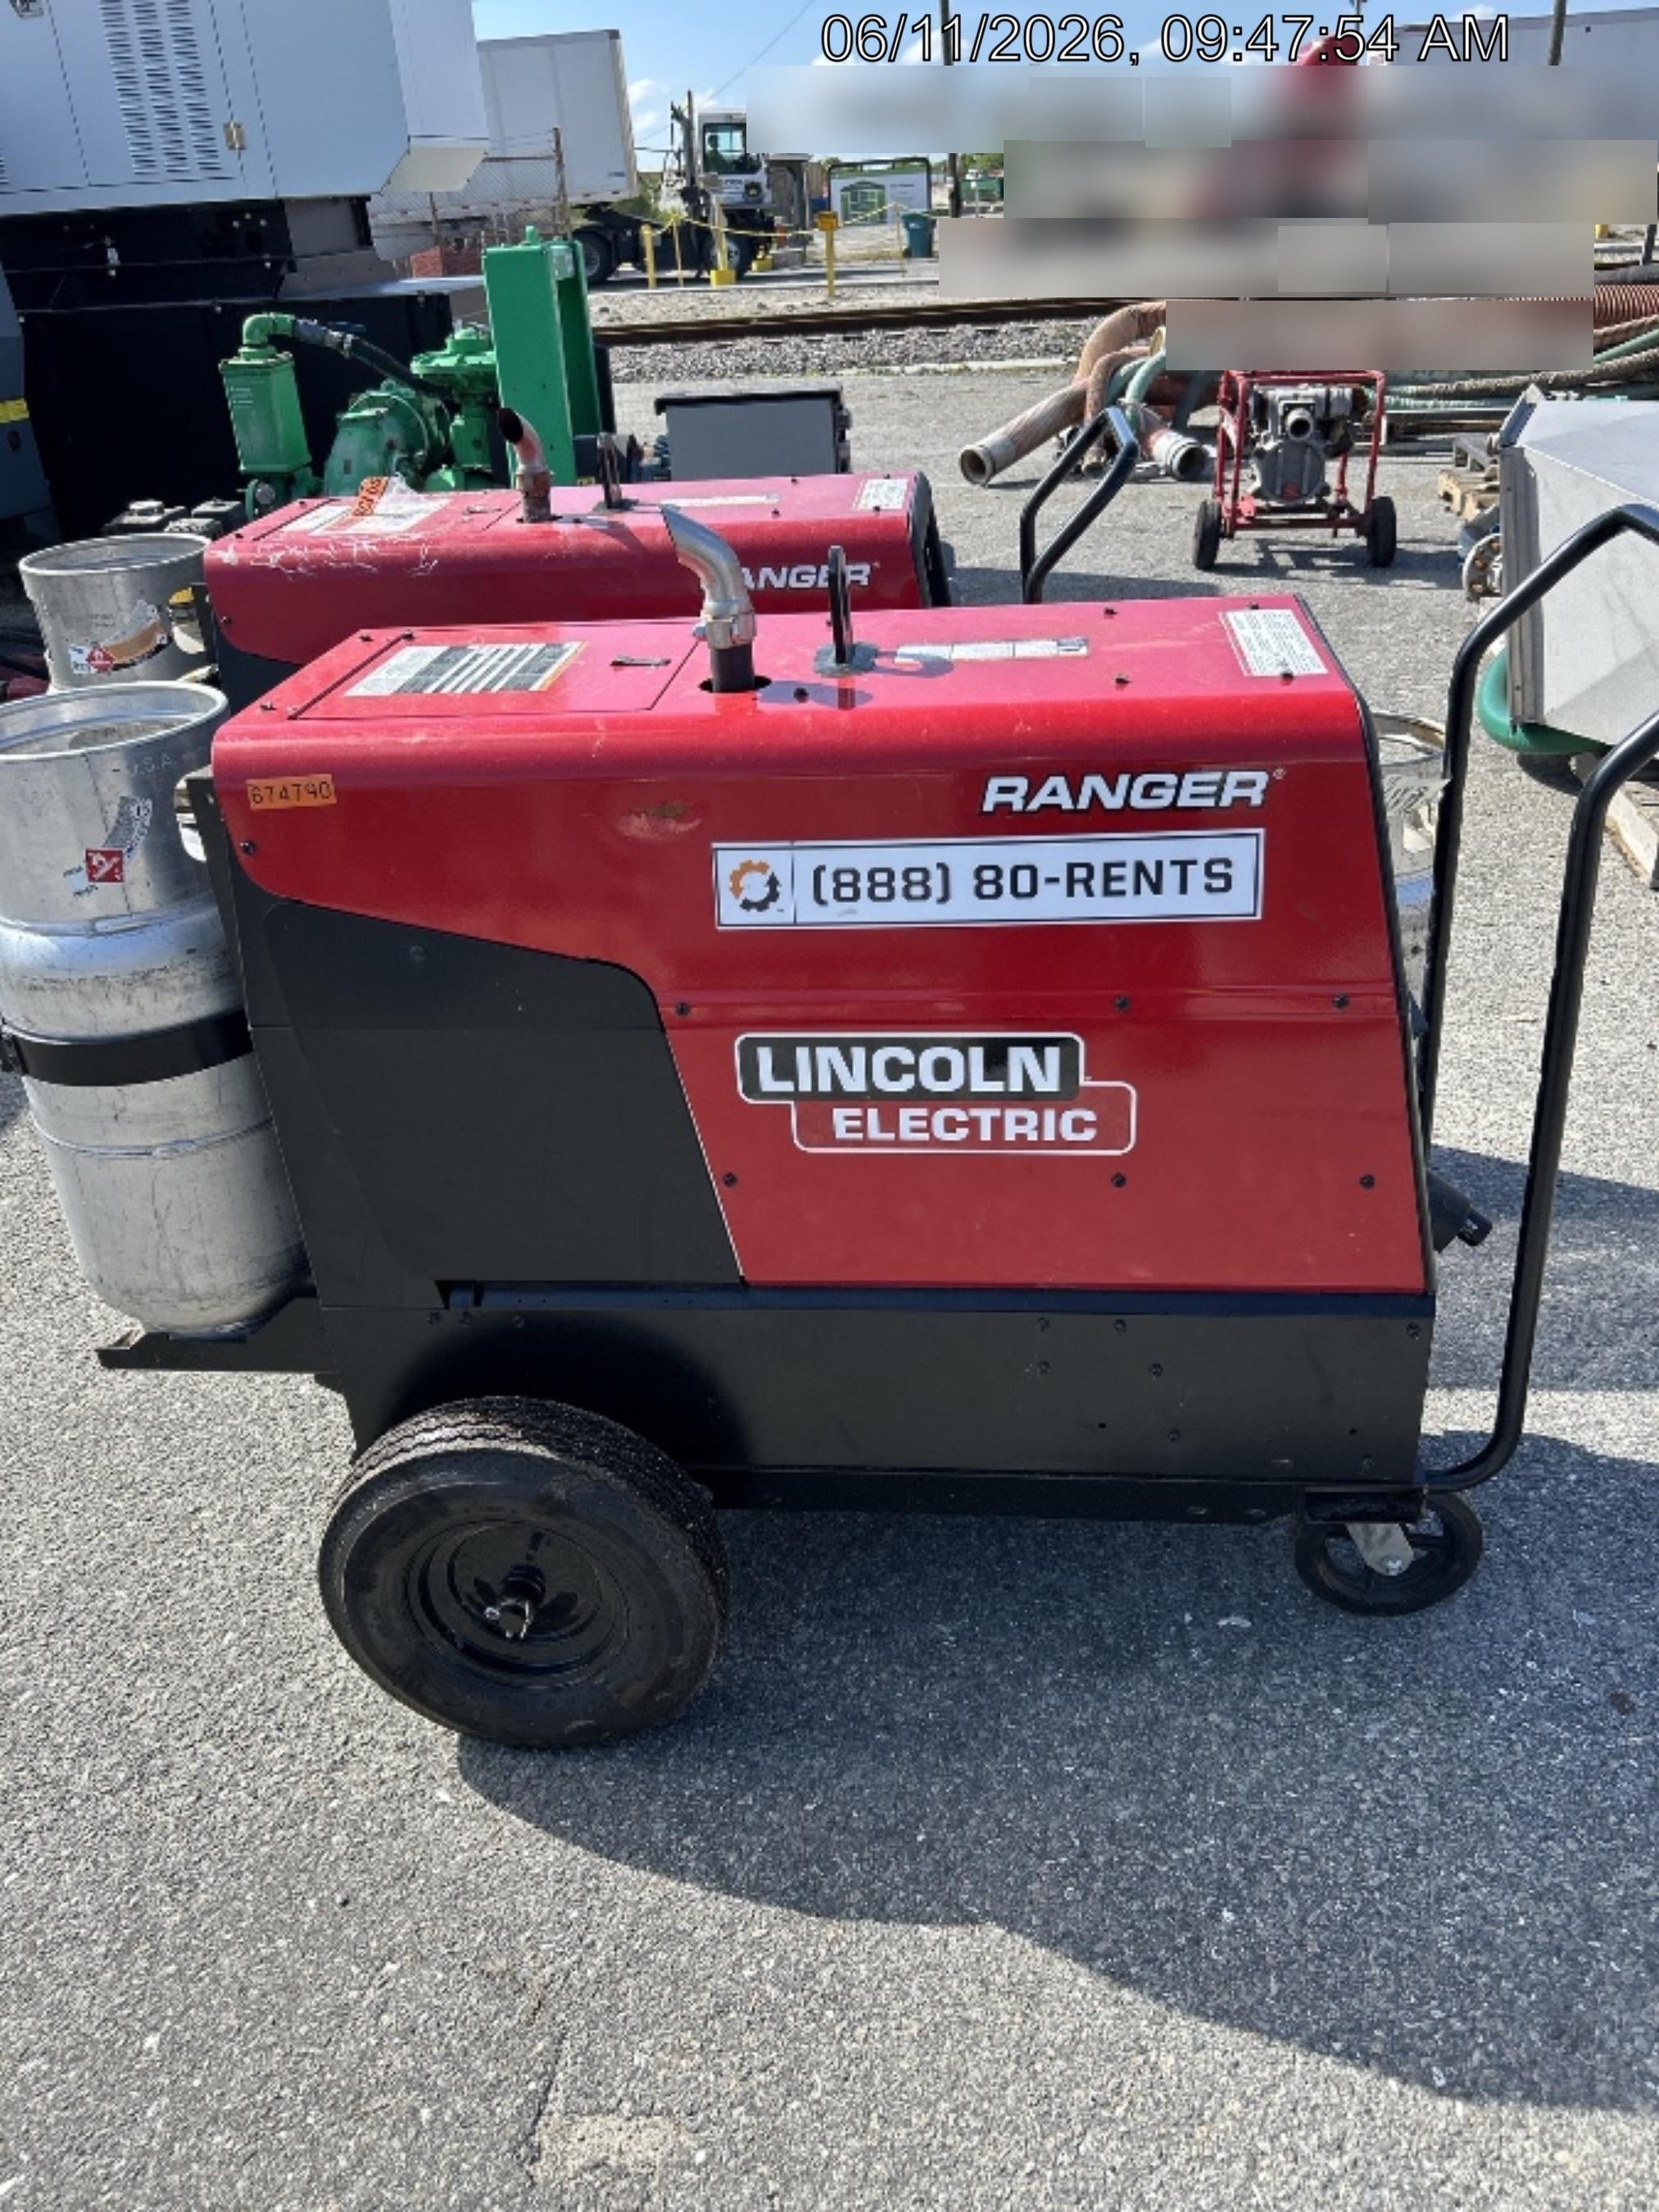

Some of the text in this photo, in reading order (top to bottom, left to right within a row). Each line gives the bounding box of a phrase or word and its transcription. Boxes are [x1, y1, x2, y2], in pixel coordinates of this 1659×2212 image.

[813, 856, 1233, 905] (888) 80-RENTS
[756, 1045, 1061, 1093] LINCOLN
[832, 1107, 1097, 1142] ELECTRIC
